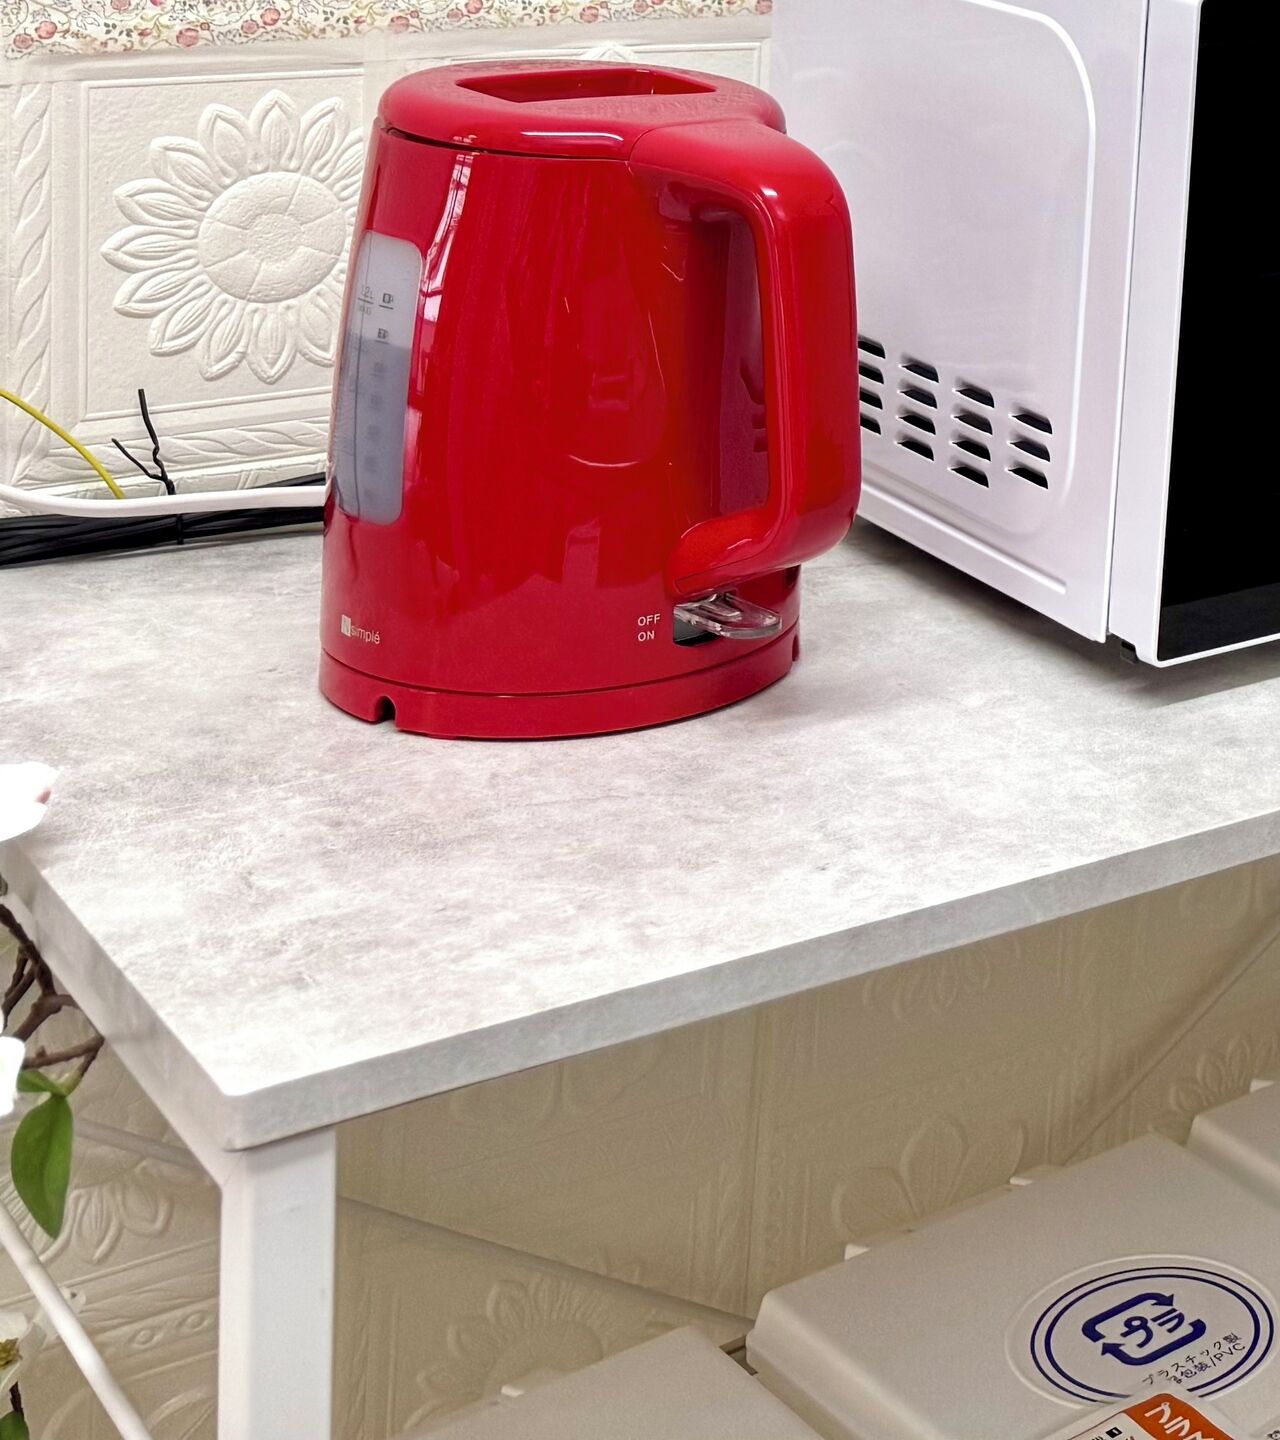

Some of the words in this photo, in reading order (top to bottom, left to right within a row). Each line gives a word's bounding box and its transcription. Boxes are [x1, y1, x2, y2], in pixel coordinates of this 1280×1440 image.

[637, 613, 661, 627] OFF
[637, 630, 655, 642] ON
[1120, 1307, 1185, 1349] プラ
